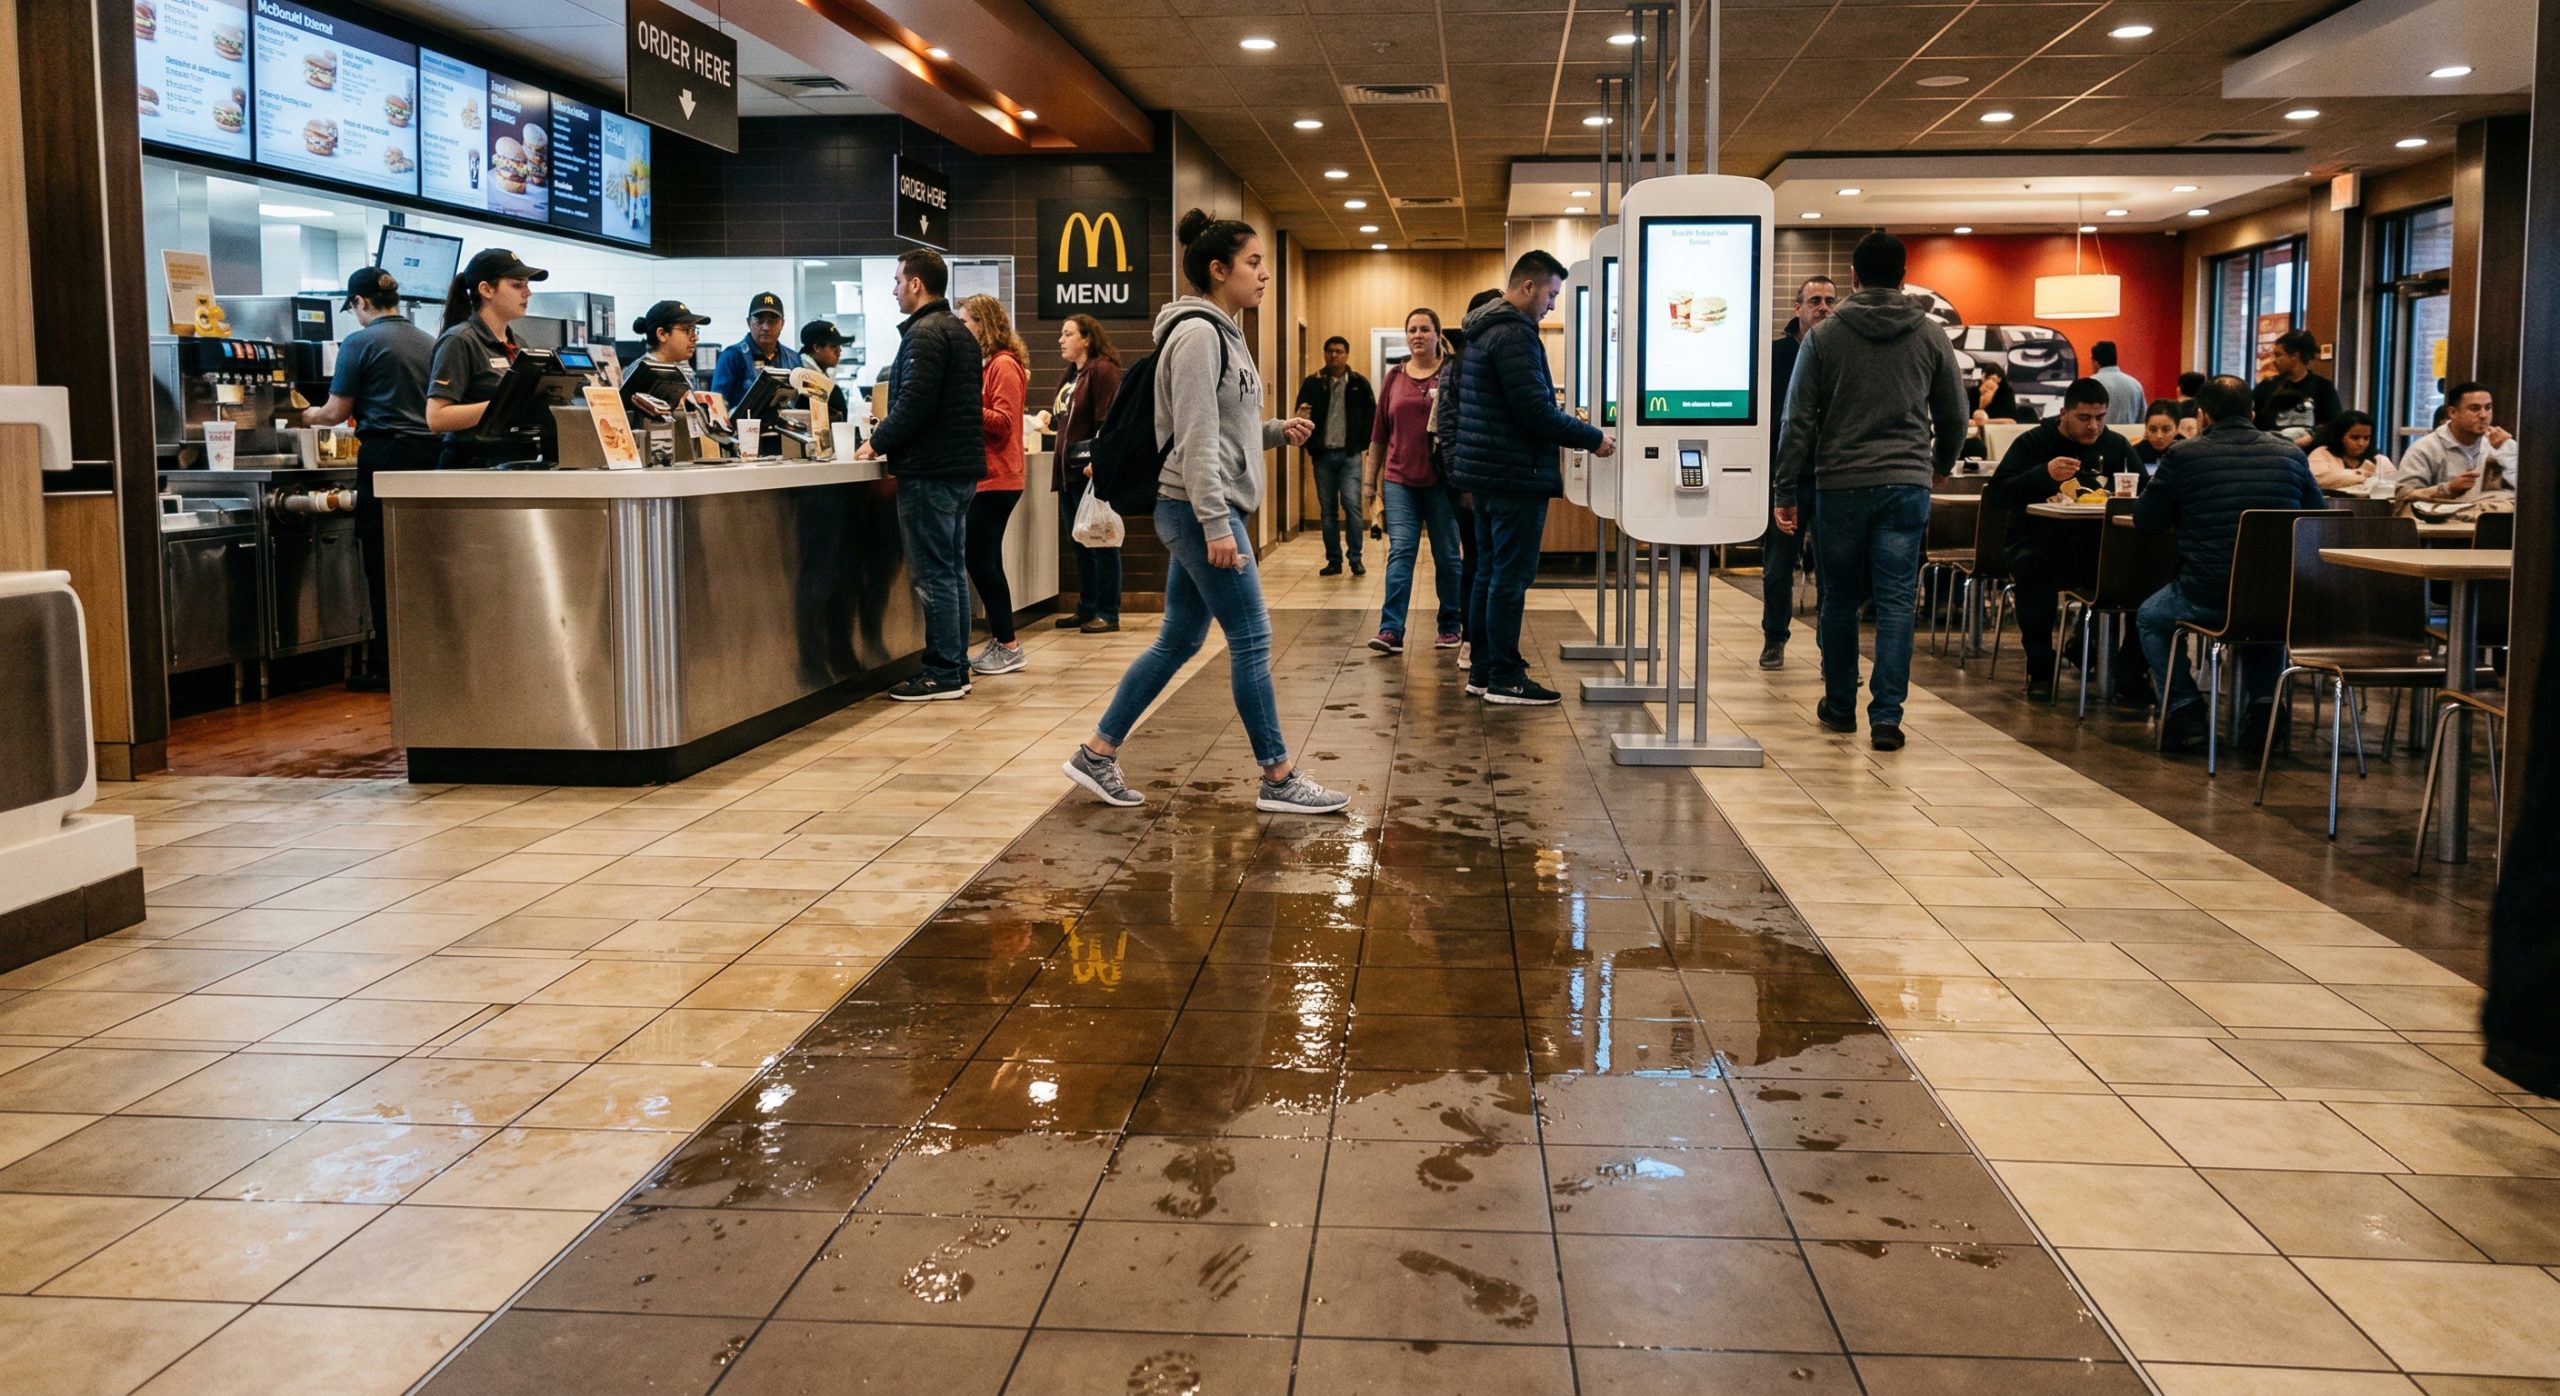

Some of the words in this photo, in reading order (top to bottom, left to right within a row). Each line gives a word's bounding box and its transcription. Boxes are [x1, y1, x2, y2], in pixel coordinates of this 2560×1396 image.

[638, 20, 690, 70] ORDER
[694, 46, 731, 87] HERE
[900, 174, 926, 203] ORDER
[927, 184, 947, 210] HERE
[1058, 211, 1127, 273] M
[1056, 283, 1129, 304] MENU
[1649, 396, 1668, 412] M
